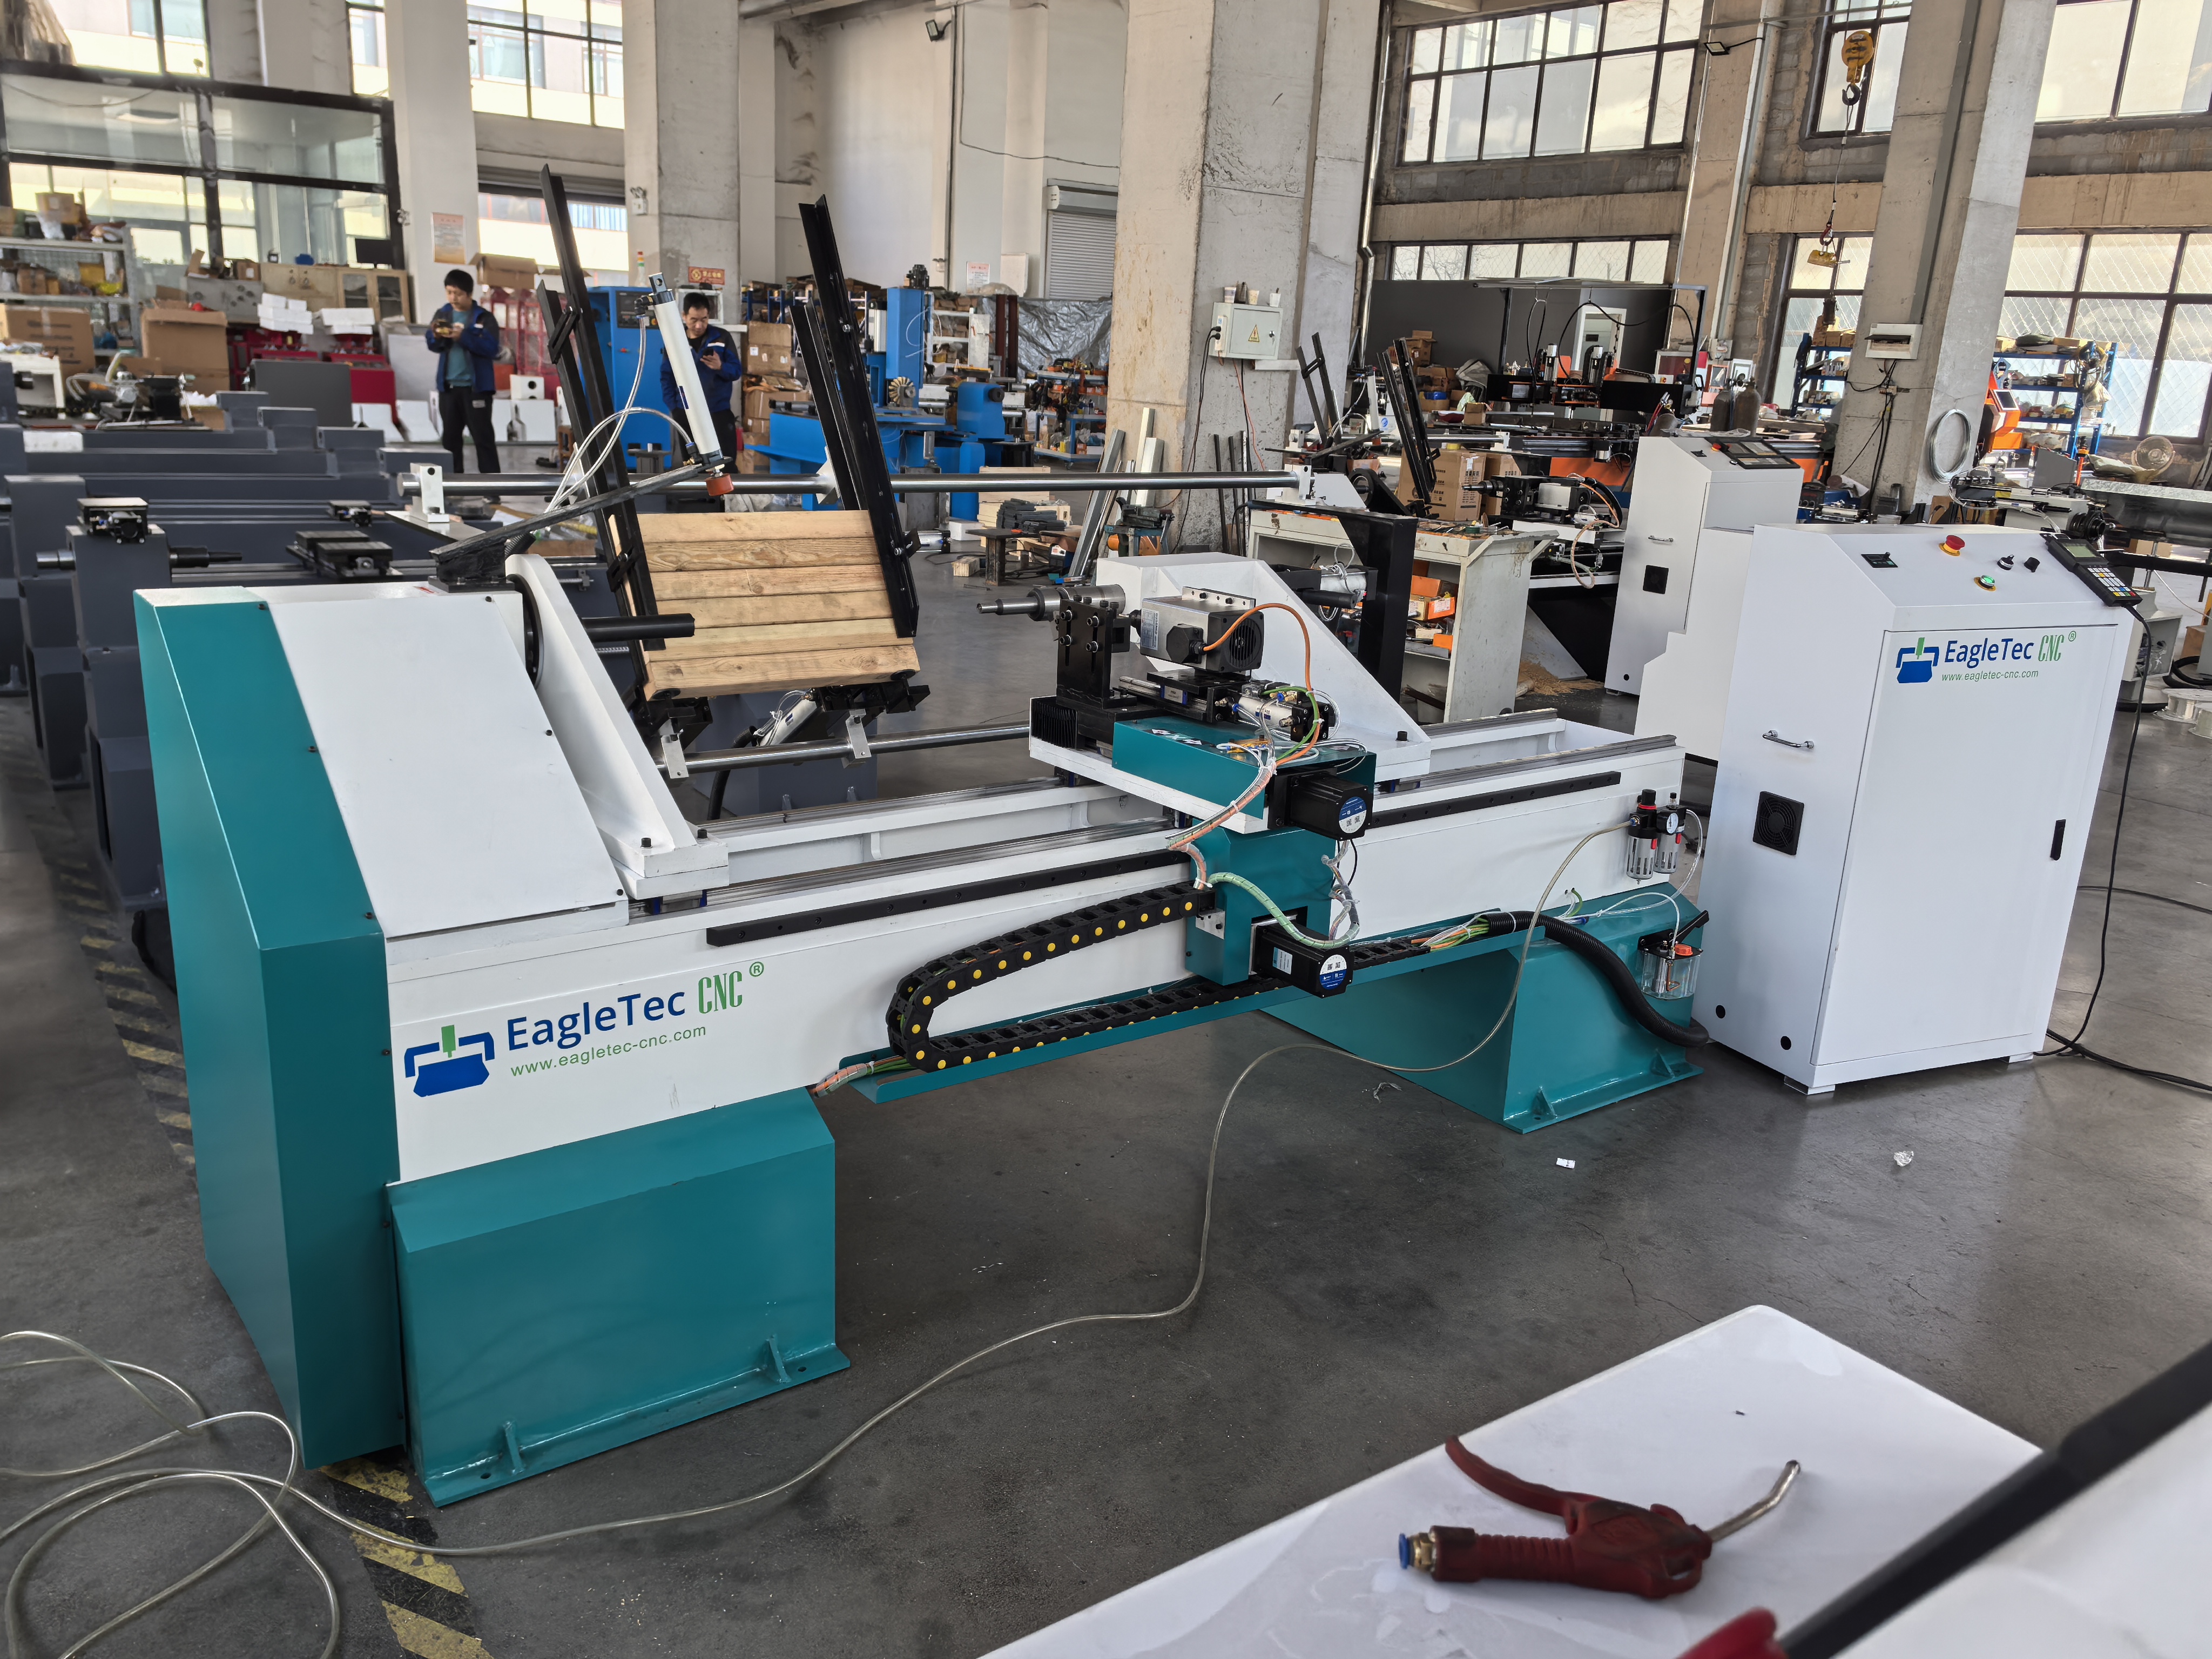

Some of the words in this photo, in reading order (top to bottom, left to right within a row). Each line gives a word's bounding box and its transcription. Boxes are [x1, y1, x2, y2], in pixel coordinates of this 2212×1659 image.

[1945, 638, 2034, 669] EagleTec
[2039, 635, 2065, 662] CNC
[1942, 670, 2039, 682] www.eagletec-cnc.com
[508, 992, 685, 1050] EagleTec
[698, 970, 743, 1014] CNC
[510, 1025, 706, 1077] www.eagletec-cnc.com
